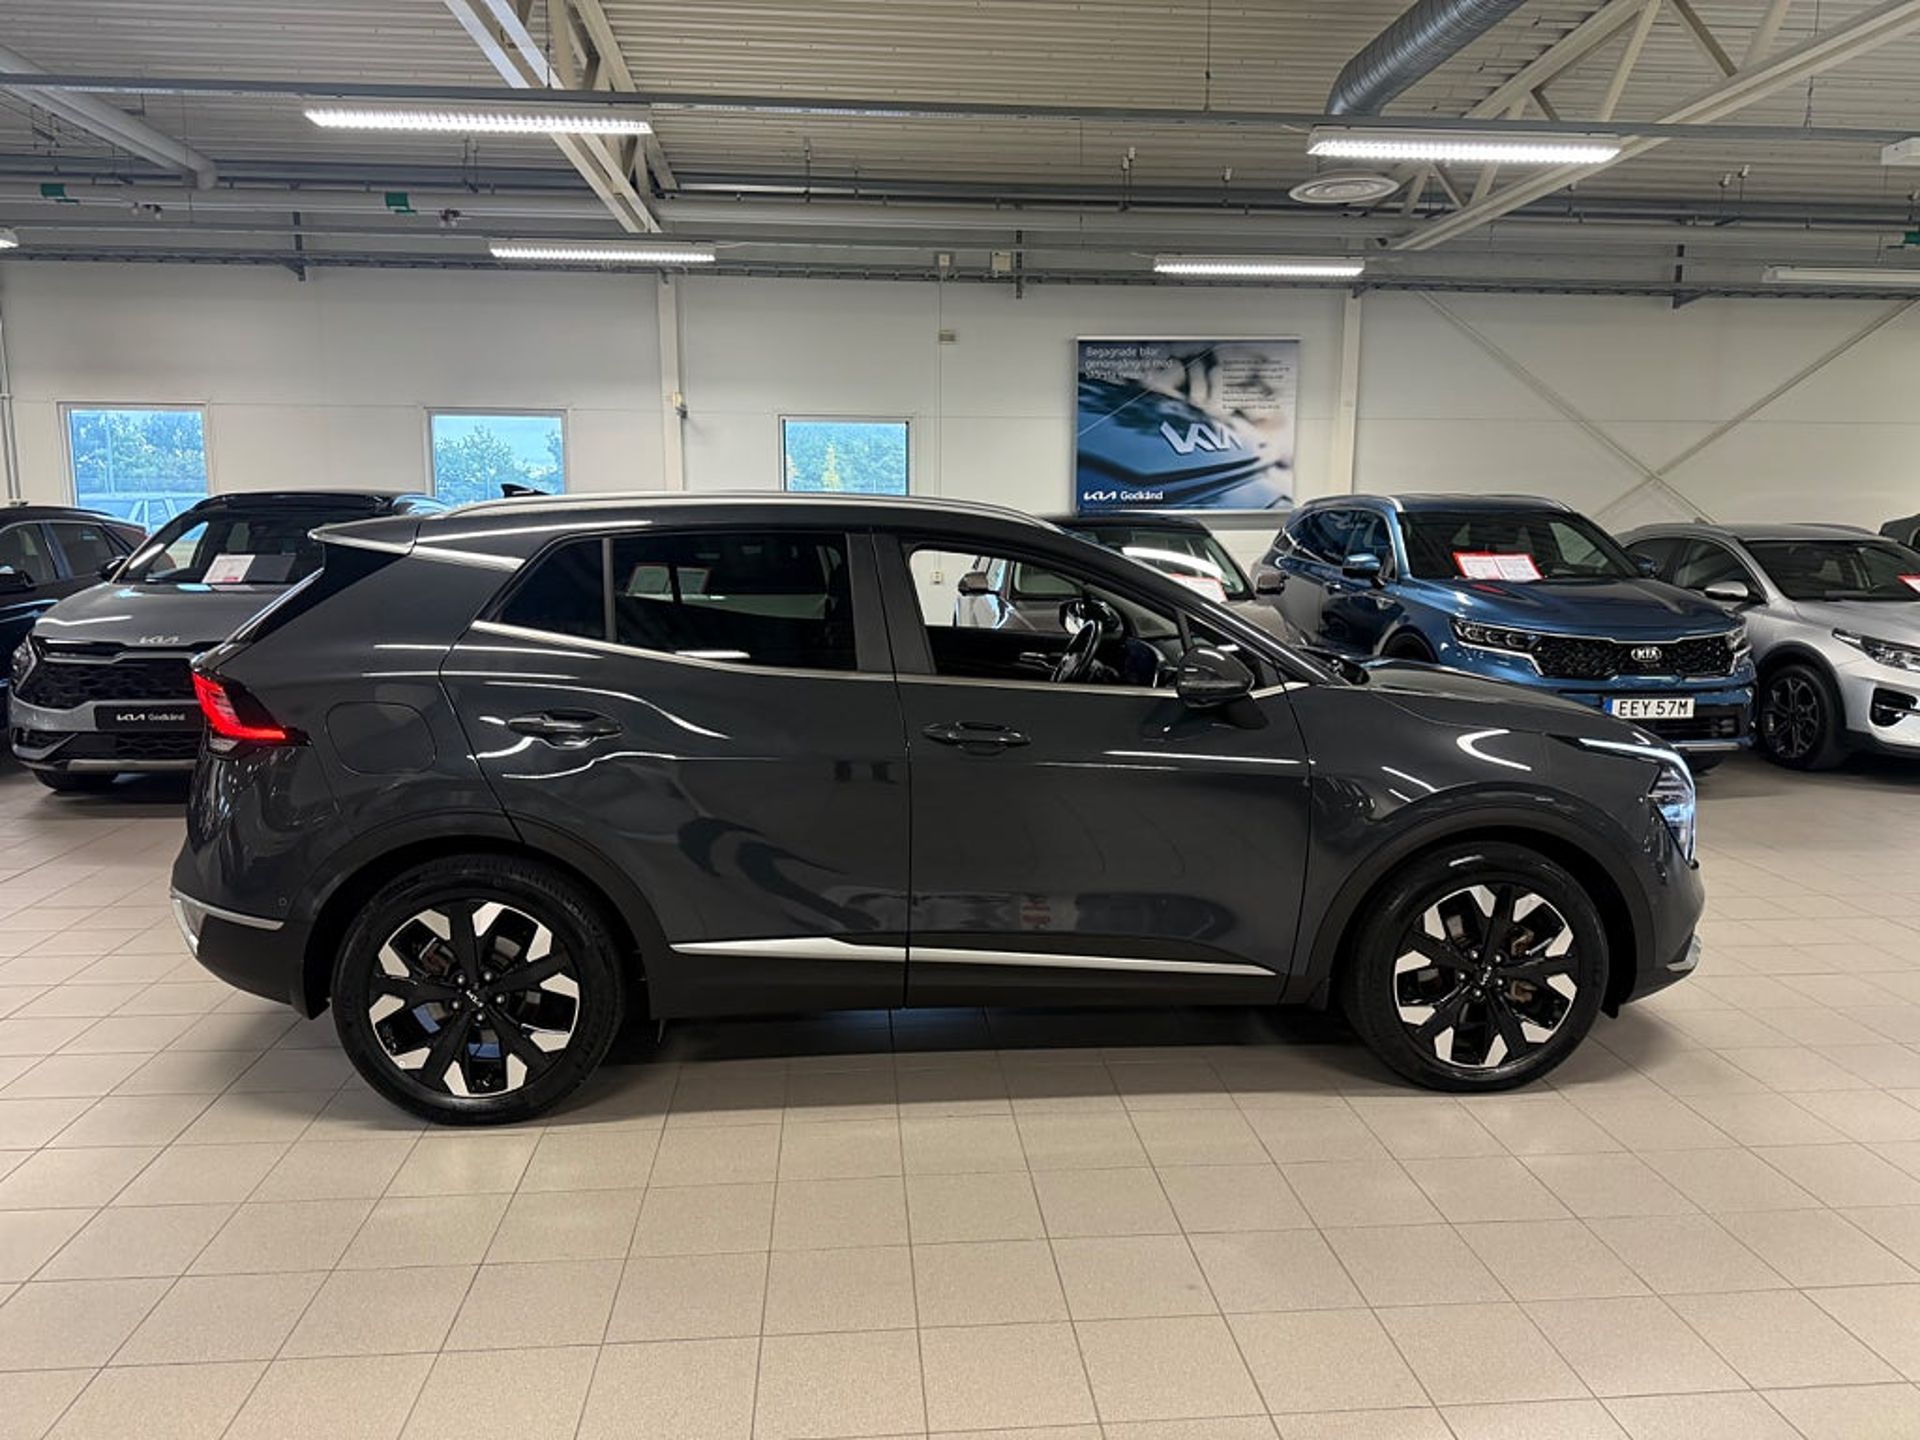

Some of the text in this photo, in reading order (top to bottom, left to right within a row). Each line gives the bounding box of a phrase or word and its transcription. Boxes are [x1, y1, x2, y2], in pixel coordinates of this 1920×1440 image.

[1083, 490, 1163, 500] KIA Godkänd
[140, 636, 179, 644] KIA
[1635, 647, 1660, 660] KIA
[1619, 701, 1689, 716] EEY 57M
